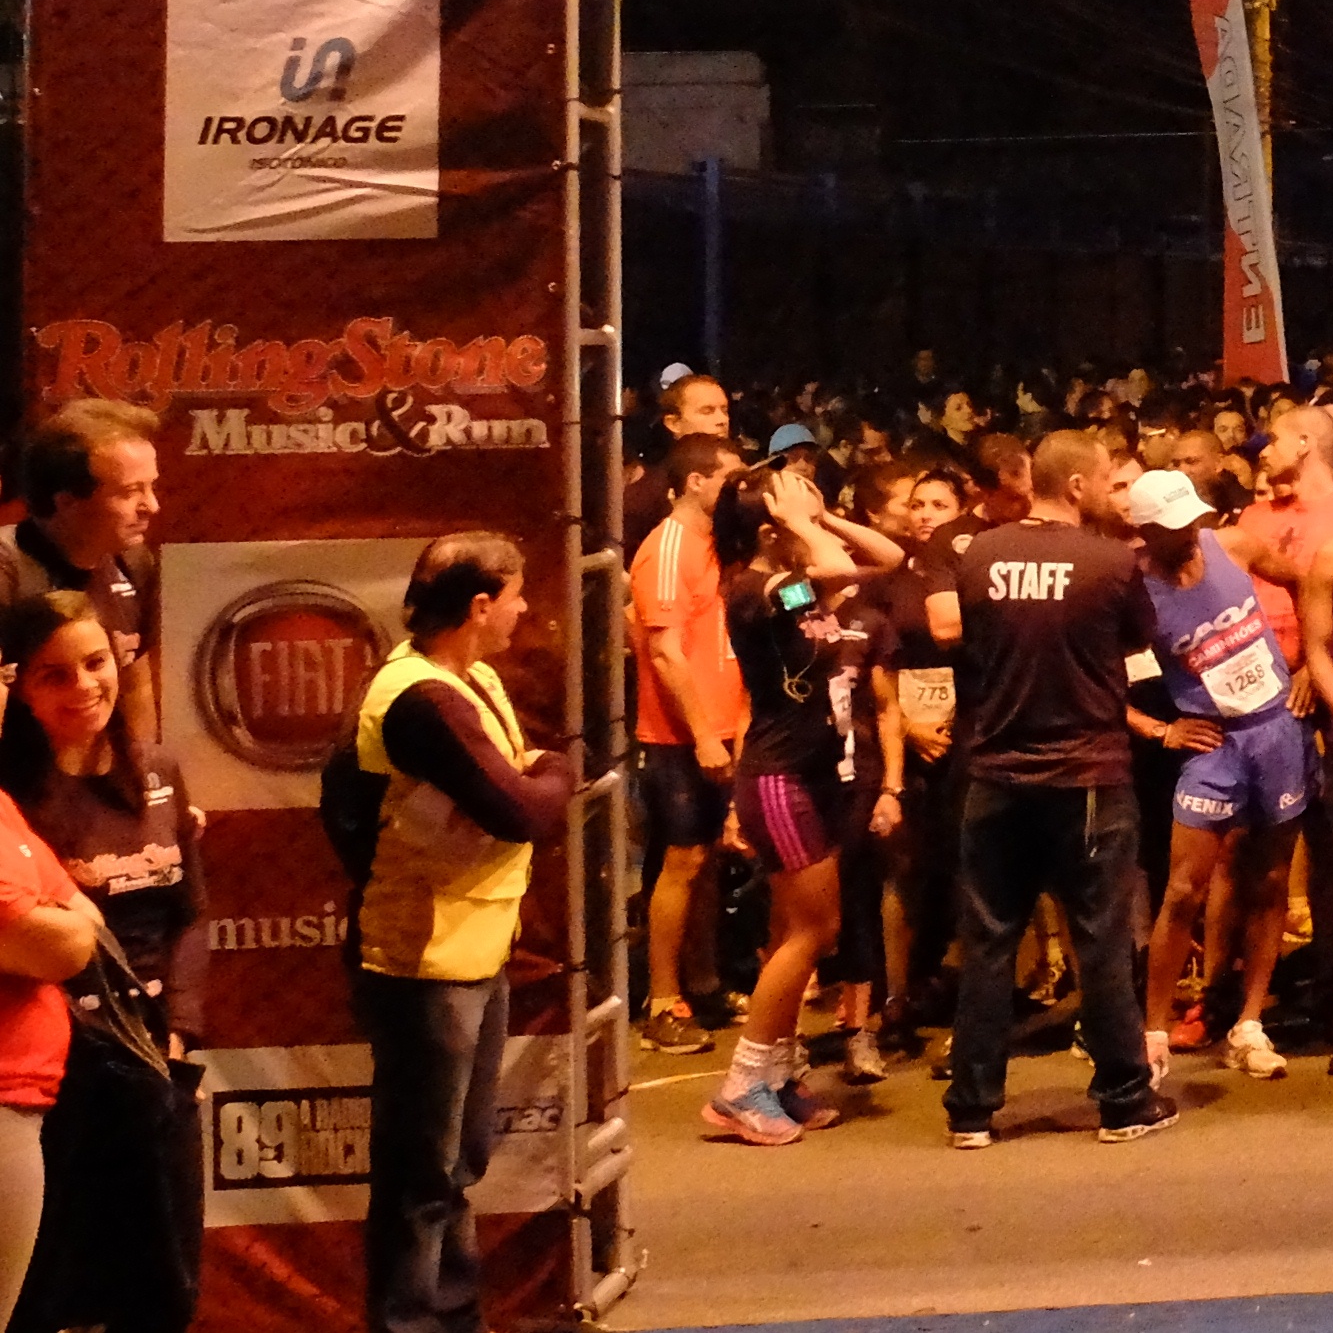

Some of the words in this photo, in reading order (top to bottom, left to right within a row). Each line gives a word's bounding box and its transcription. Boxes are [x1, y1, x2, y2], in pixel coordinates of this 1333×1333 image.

[197, 114, 407, 146] IRONAGE
[987, 561, 1074, 601] STAFF
[250, 638, 353, 717] FIAT
[916, 685, 950, 701] 778
[220, 1100, 299, 1180] 89
